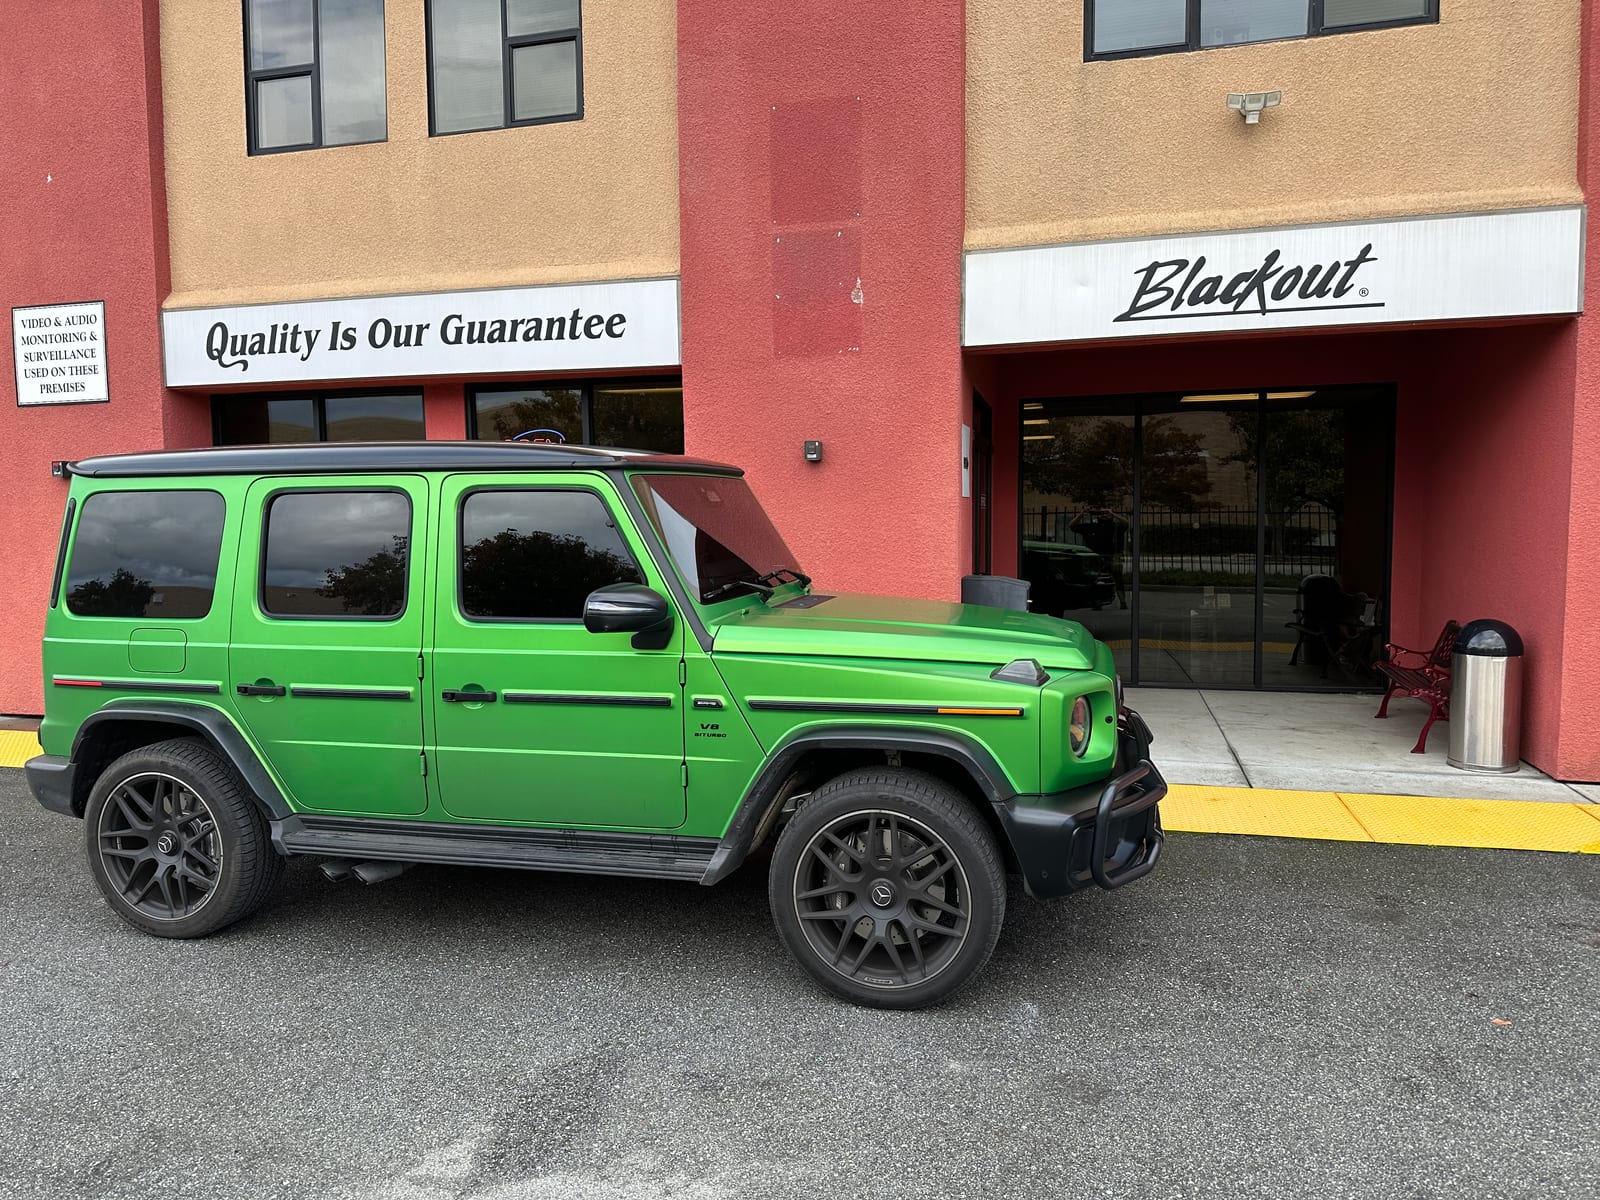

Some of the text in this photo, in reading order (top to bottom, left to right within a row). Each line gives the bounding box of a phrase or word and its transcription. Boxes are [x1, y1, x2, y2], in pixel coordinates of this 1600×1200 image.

[21, 314, 97, 329] VIDEO & AUDIO
[21, 331, 98, 346] MONITORING &
[206, 308, 627, 372] Quality Is Our Guarantee
[23, 348, 97, 363] SURVEILLANCE
[24, 364, 99, 379] USED ON THESE
[40, 382, 86, 394] PREMISES
